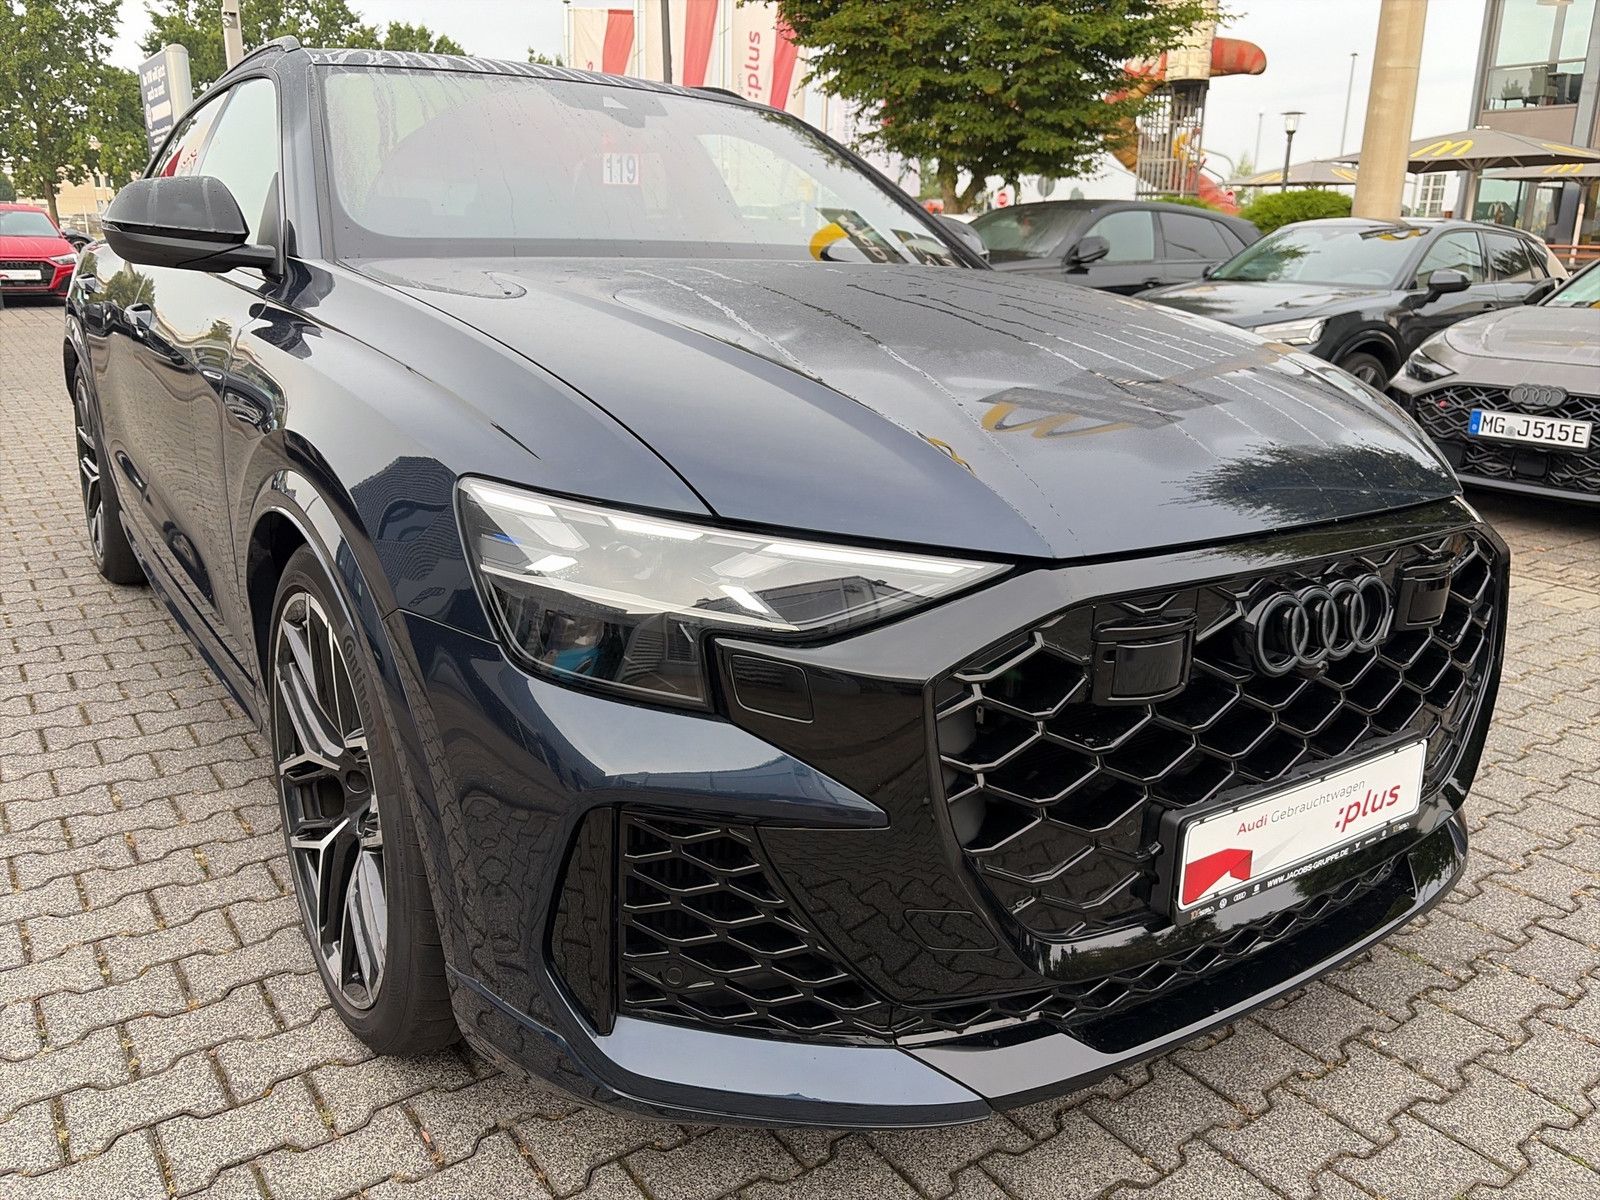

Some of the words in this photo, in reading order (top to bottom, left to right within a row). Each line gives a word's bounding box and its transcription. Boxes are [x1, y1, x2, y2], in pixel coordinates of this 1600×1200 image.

[744, 30, 763, 99] :plus
[606, 154, 636, 184] 119
[1481, 415, 1506, 434] MG
[1517, 419, 1586, 444] J515E
[1236, 814, 1268, 836] Audi
[1271, 779, 1366, 823] Gebrauchtwagen
[1334, 784, 1401, 833] :plus
